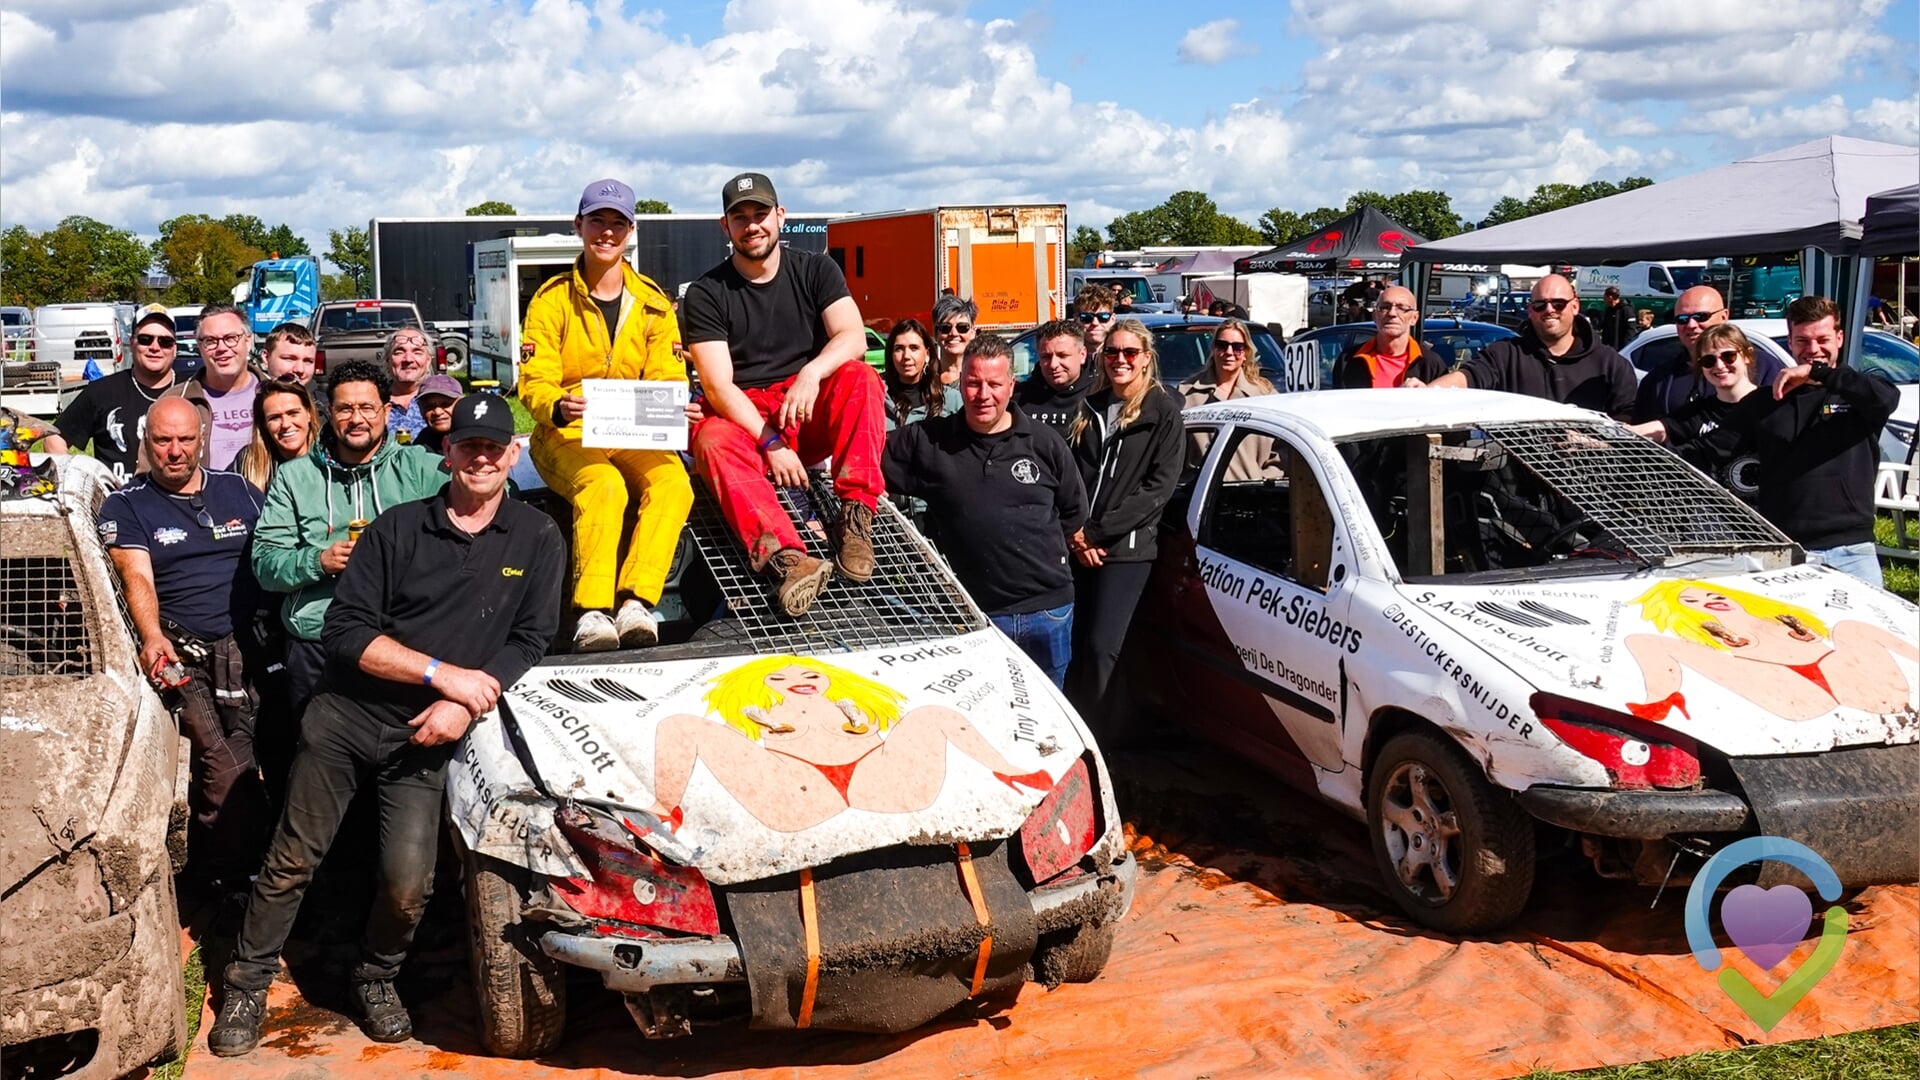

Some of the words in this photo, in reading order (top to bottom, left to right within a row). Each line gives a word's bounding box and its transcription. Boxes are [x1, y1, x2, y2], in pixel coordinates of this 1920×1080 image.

[792, 224, 805, 233] all
[1286, 342, 1315, 393] 320
[1216, 408, 1252, 421] Elektro
[1752, 571, 1823, 588] Porkie
[1487, 588, 1536, 597] Willie
[1541, 589, 1600, 600] Rutten
[1245, 576, 1363, 654] Pek-Siebers
[1416, 590, 1569, 663] S.Ackerschott
[878, 644, 963, 667] Porkie
[1601, 644, 1613, 664] club
[553, 666, 599, 676] Willie
[923, 668, 974, 694] Tjabo
[1260, 652, 1275, 674] De
[1276, 662, 1338, 704] Dragonder
[956, 681, 1000, 712] Dikkop
[636, 701, 660, 719] club
[508, 682, 617, 774] S.Ackerschott
[1013, 714, 1039, 744] Tiny
